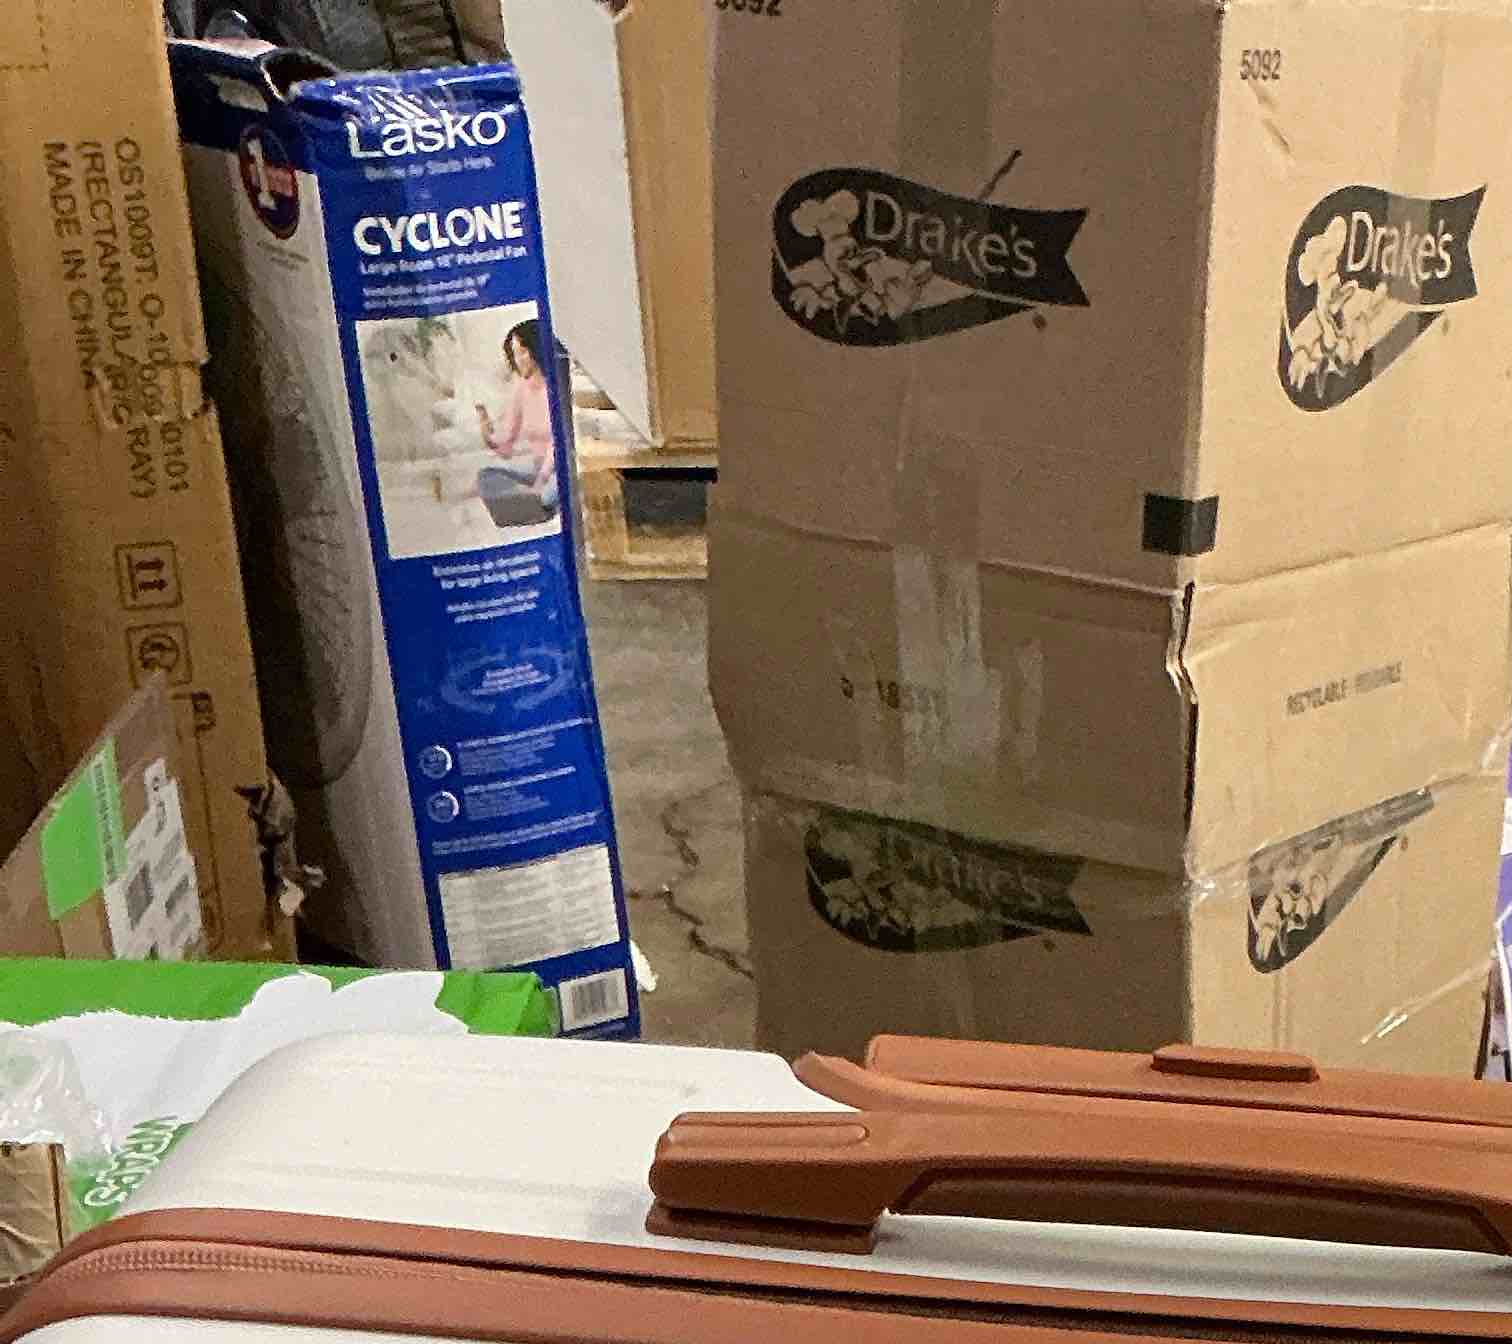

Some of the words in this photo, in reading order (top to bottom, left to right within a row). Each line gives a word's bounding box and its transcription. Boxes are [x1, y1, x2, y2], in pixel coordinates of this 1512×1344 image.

[1239, 49, 1281, 80] 5092
[346, 110, 506, 158] Lasko
[44, 142, 82, 239] MADE
[354, 201, 526, 255] CYCLONE
[864, 192, 1037, 278] Drake's
[1346, 211, 1452, 288] Drake's
[61, 249, 87, 281] IN
[68, 289, 99, 390] CHINA
